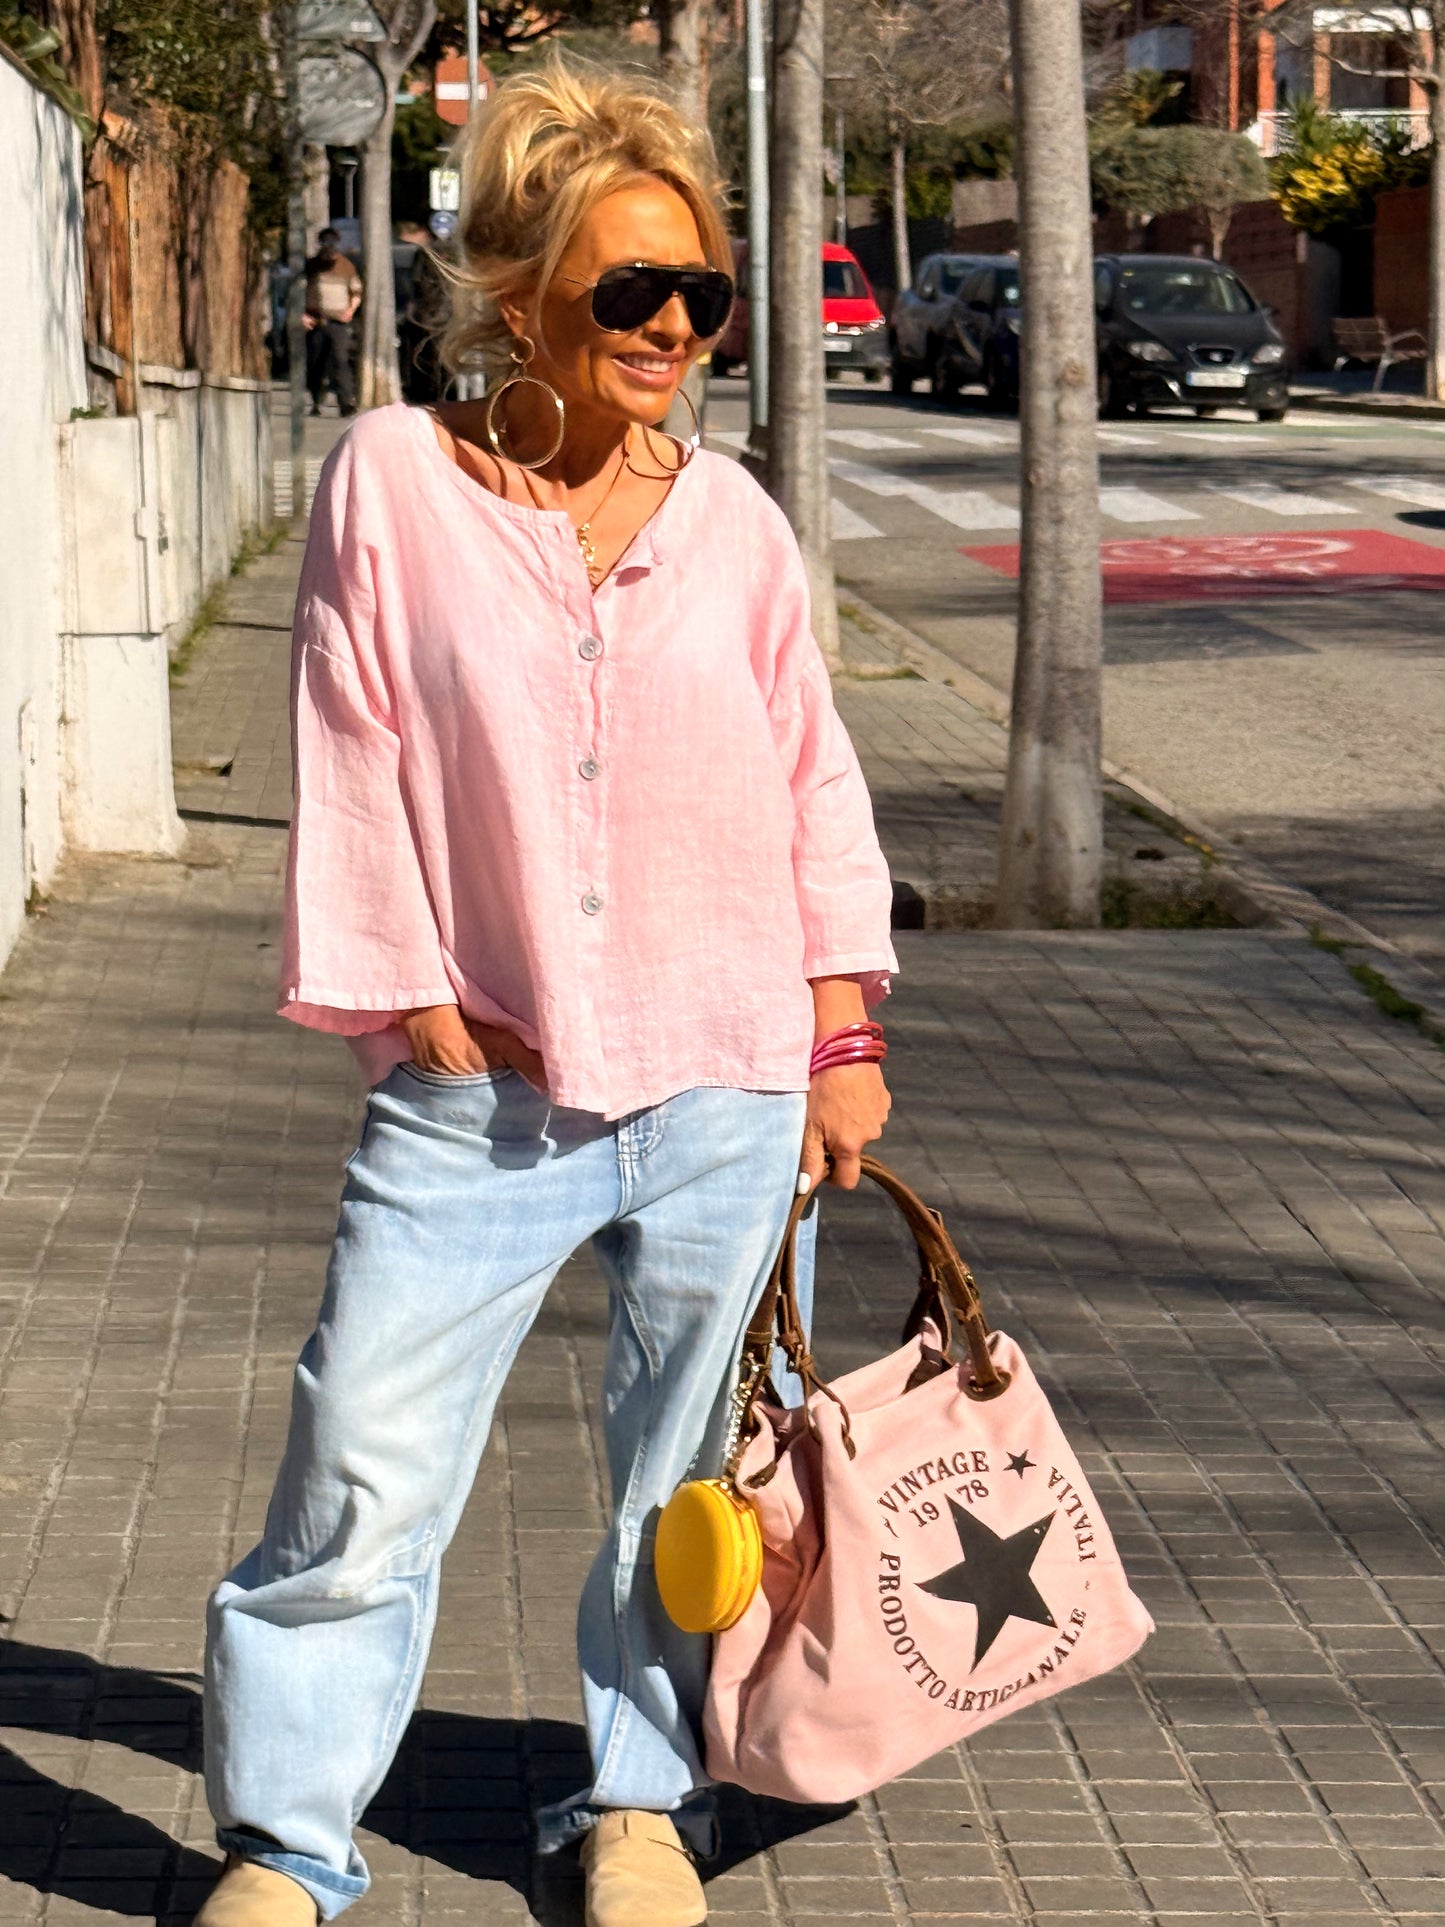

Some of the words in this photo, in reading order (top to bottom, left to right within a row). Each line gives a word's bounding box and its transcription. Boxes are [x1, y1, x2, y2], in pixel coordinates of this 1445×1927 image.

[877, 1450, 990, 1513] VINTAGE
[908, 1501, 940, 1528] 19
[956, 1479, 989, 1504] 78
[1047, 1466, 1096, 1562] ITALIA
[878, 1551, 947, 1699] PRODOTTO
[944, 1608, 1087, 1711] ARTIGIANALE
